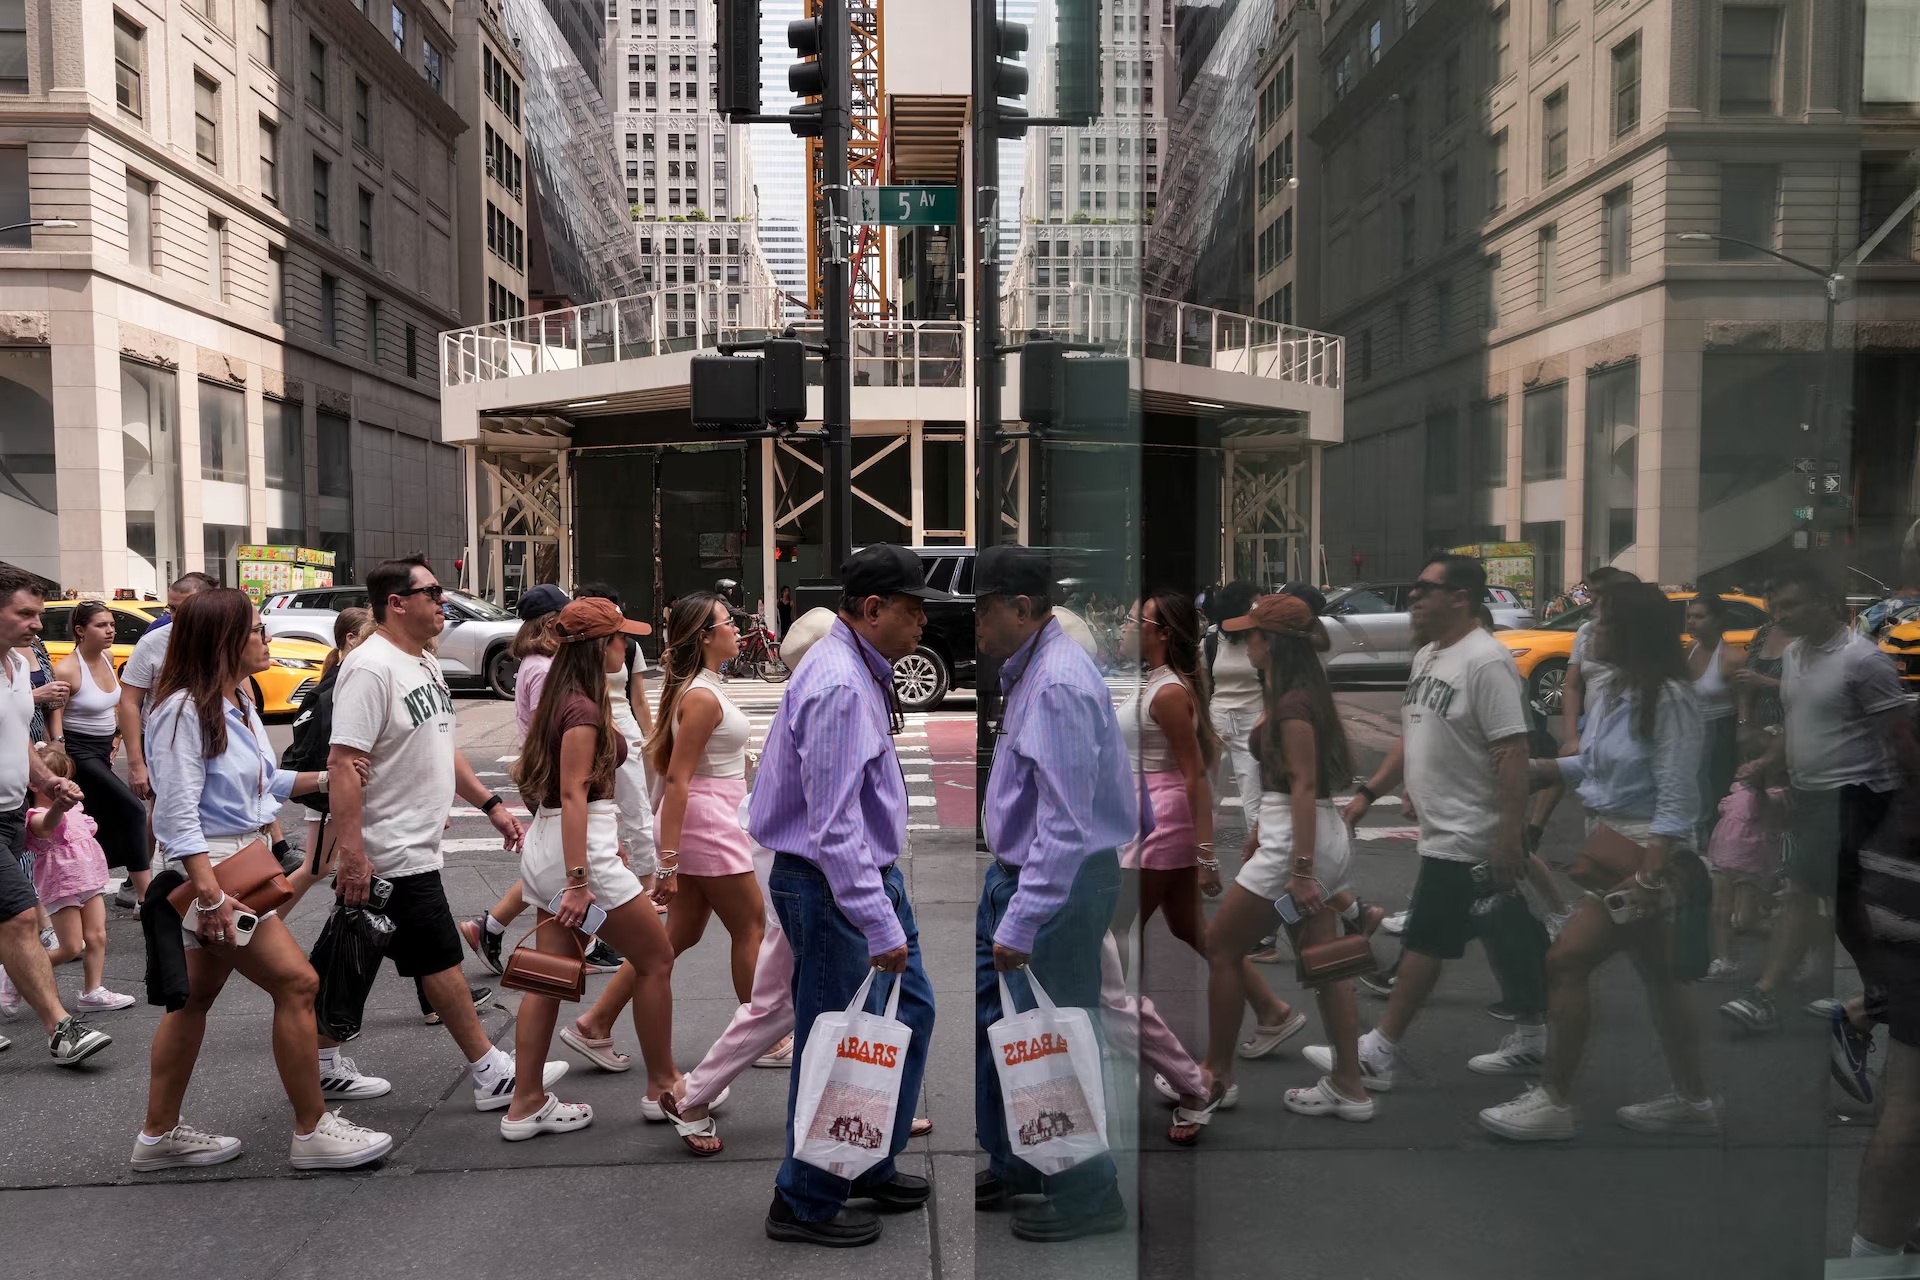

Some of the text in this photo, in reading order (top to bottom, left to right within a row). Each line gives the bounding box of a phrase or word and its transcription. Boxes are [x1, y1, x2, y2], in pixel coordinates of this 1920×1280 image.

[899, 190, 936, 220] 5 Av
[404, 683, 438, 729] NEW
